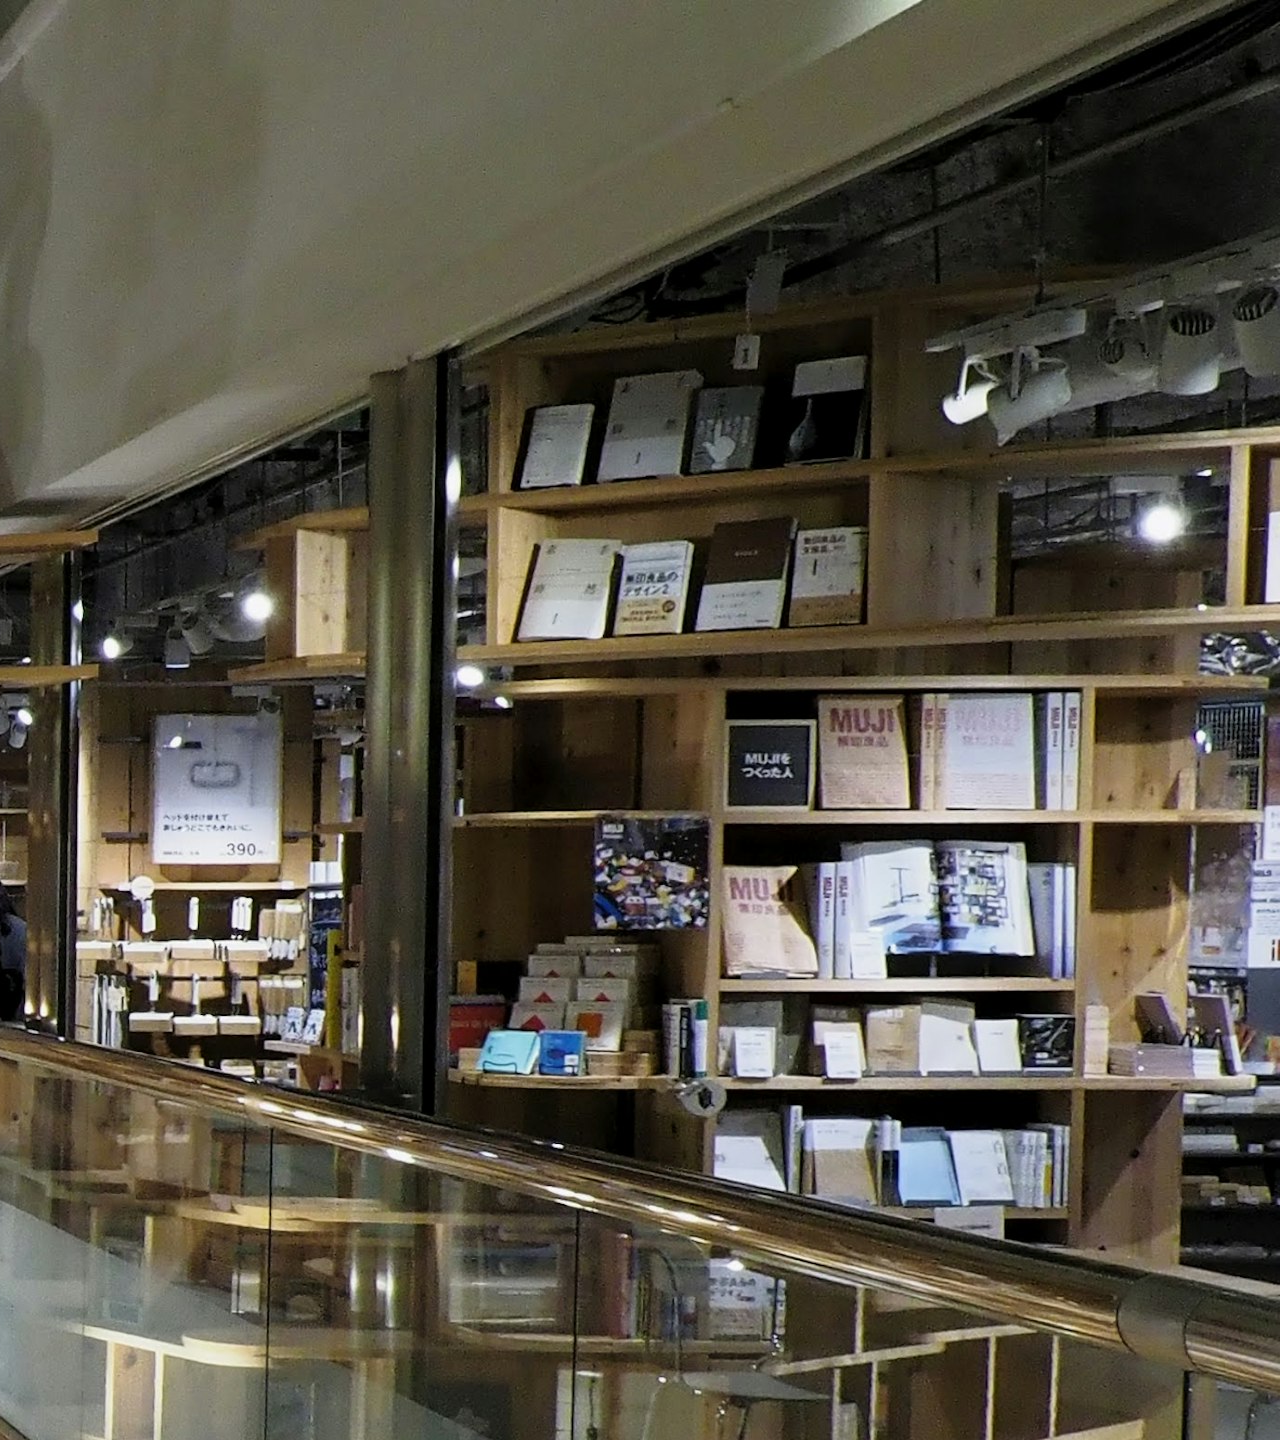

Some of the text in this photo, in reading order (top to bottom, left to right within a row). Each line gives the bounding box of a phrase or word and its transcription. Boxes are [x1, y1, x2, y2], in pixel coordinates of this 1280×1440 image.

[830, 708, 895, 733] MUJI
[745, 752, 791, 765] MUJIを
[742, 766, 794, 779] つくった人
[226, 842, 257, 856] 390
